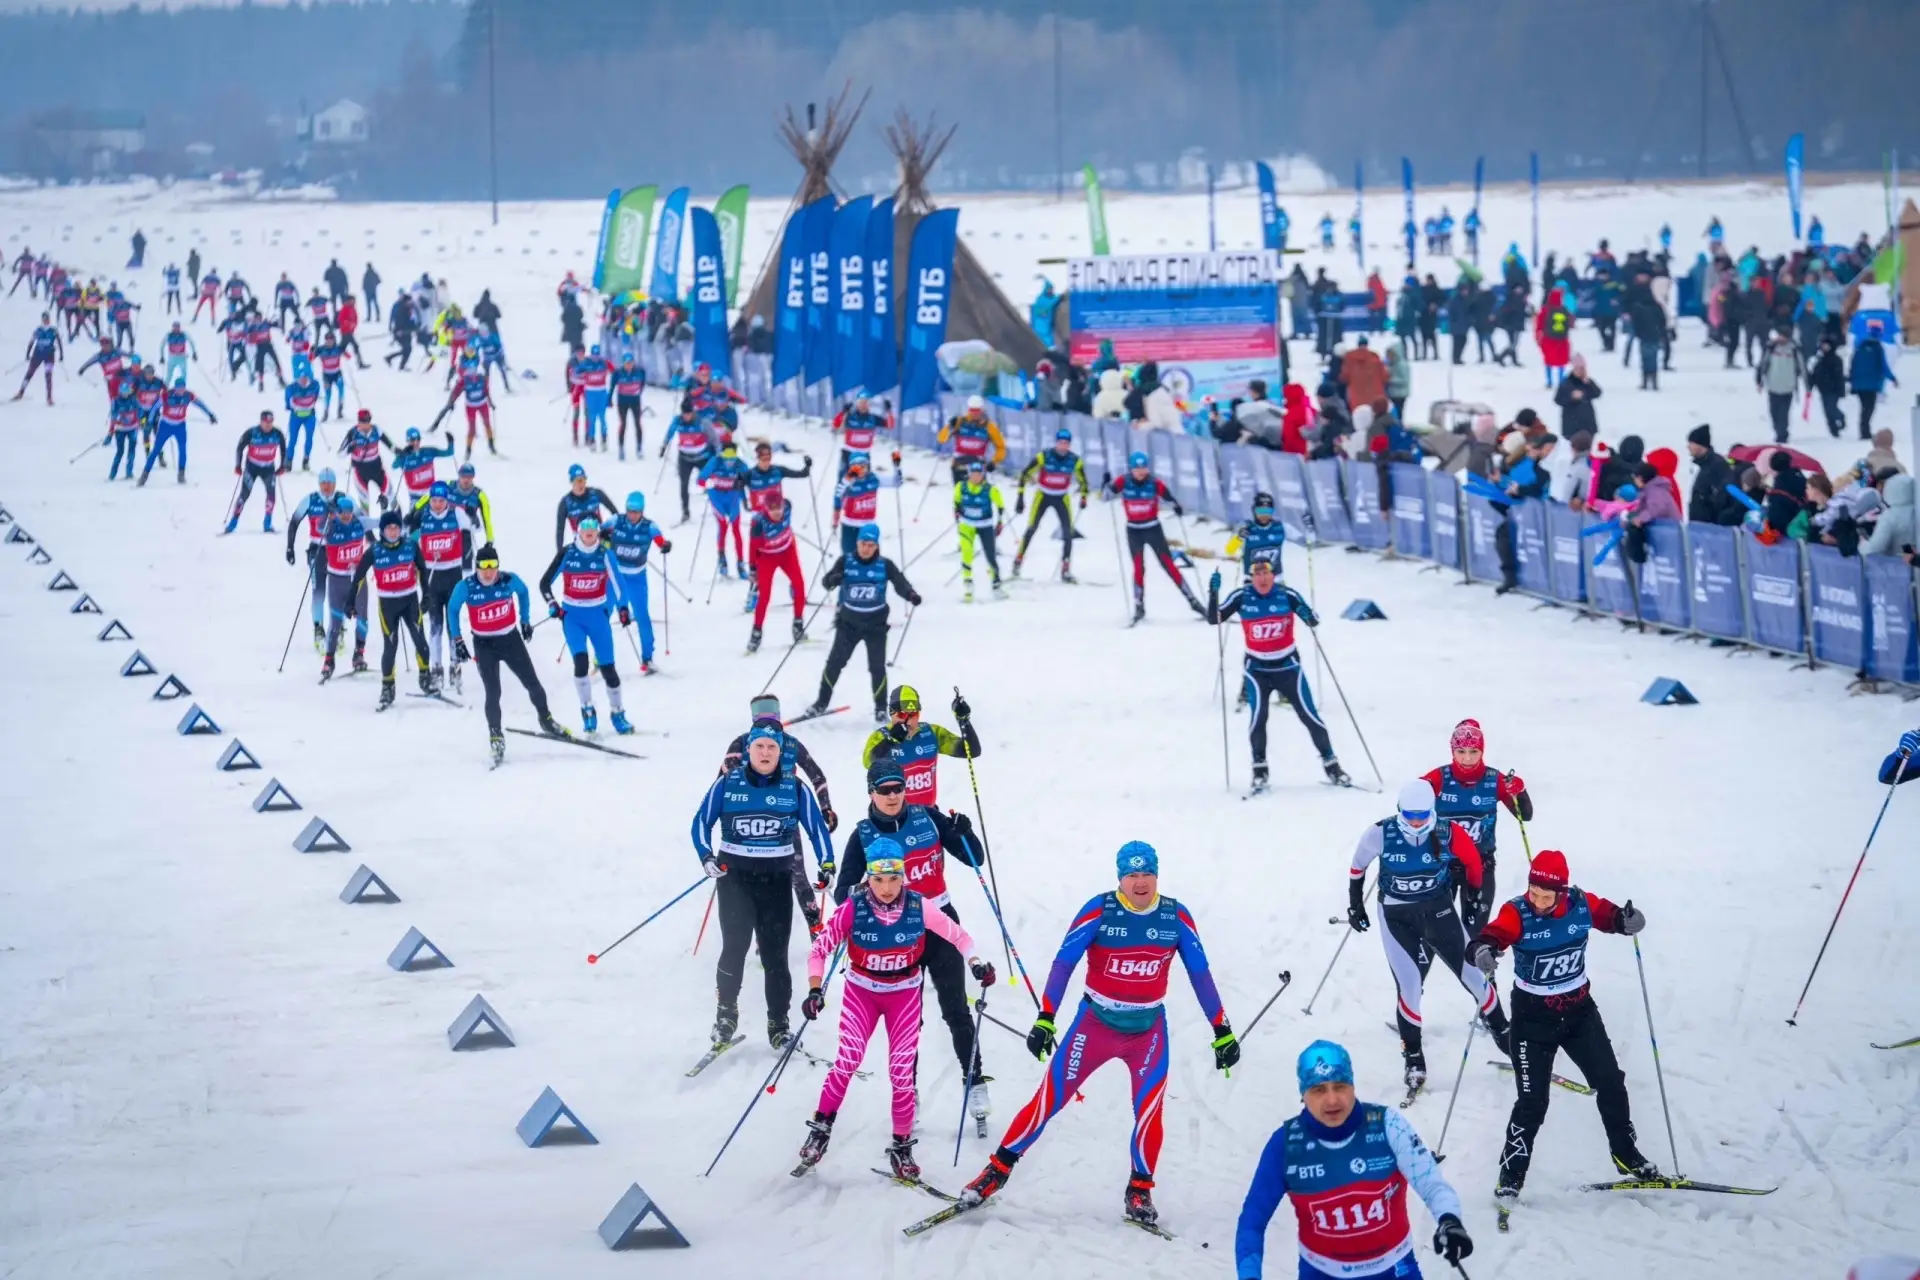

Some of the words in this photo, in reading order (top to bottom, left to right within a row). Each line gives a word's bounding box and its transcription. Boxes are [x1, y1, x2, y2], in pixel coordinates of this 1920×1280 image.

[810, 251, 829, 304] ВТБ
[841, 255, 864, 310] ВТБ
[917, 267, 945, 325] ВТБ
[480, 604, 509, 620] 1110
[1252, 622, 1283, 639] 972
[731, 793, 749, 802] ВТБ
[735, 818, 781, 837] 502
[1389, 854, 1407, 863] ВТБ
[1531, 869, 1561, 881] agil-Ski
[860, 932, 879, 942] ВТБ
[1107, 927, 1128, 937] ВТБ
[1108, 958, 1161, 976] 1540
[1539, 949, 1582, 980] 732
[1066, 1033, 1087, 1080] RUSSIA
[1519, 1041, 1531, 1092] Tagil-Ski
[1298, 1164, 1325, 1179] ВТБ
[1315, 1198, 1385, 1231] 1114
